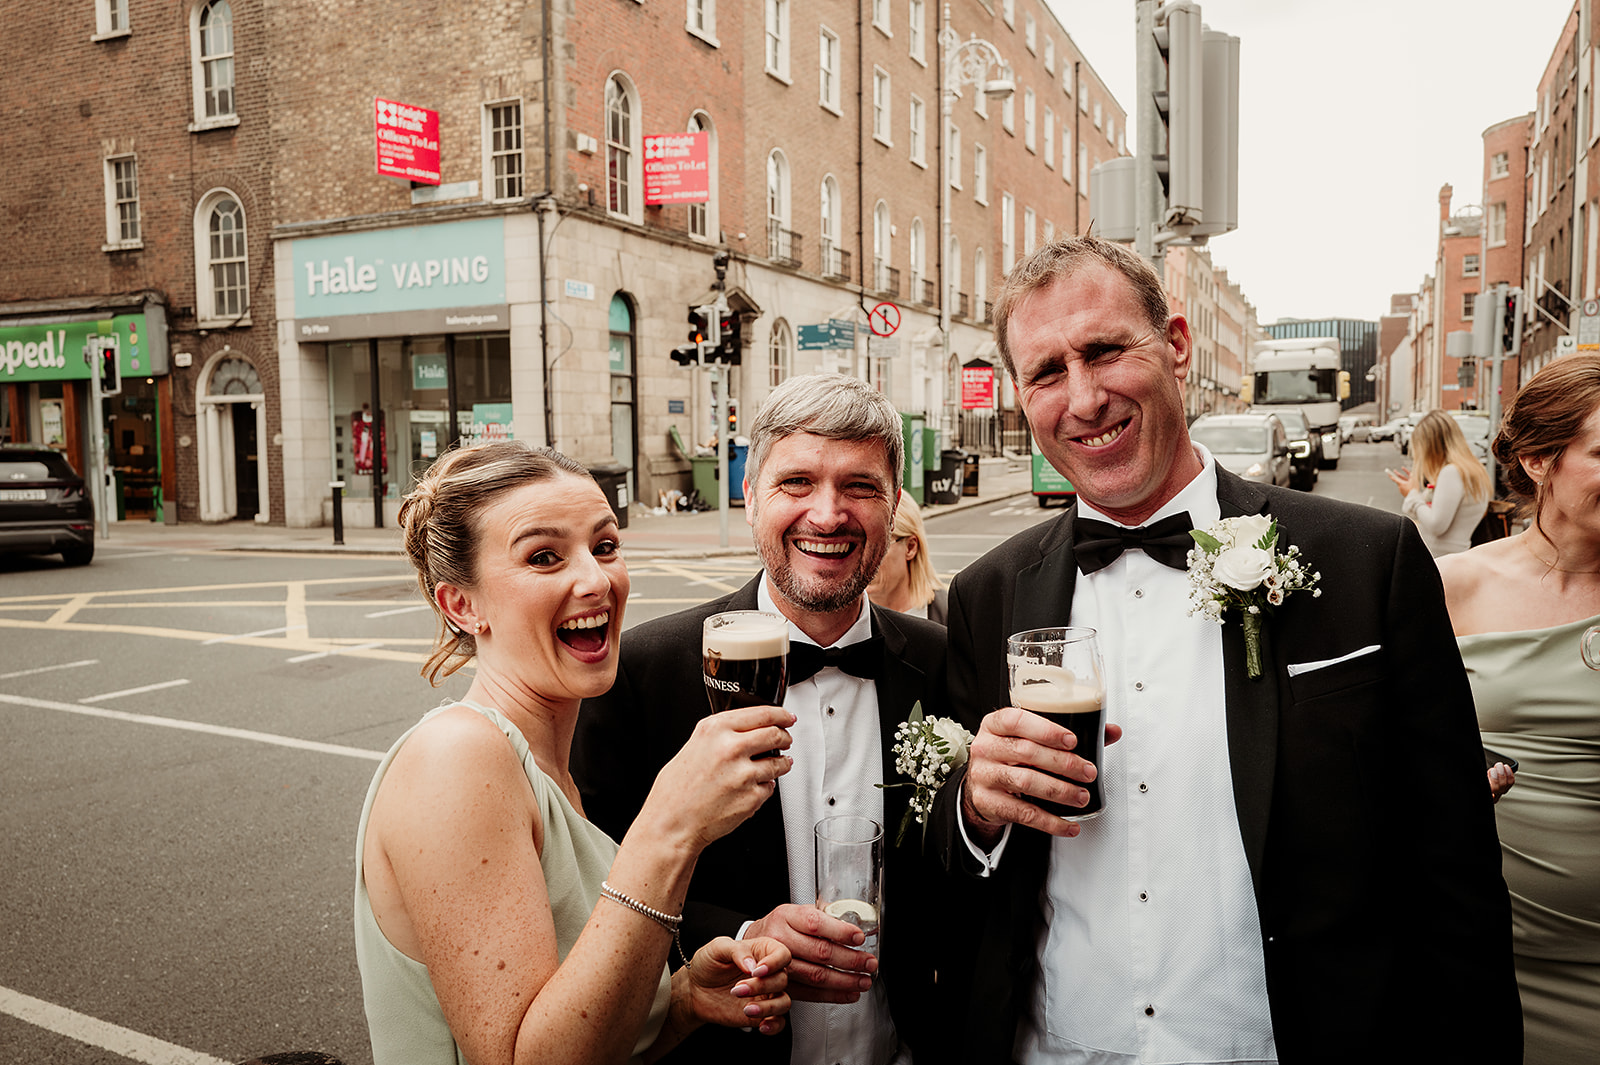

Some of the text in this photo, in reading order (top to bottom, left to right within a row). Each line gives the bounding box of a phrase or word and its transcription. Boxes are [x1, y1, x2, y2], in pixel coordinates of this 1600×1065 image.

[397, 105, 427, 122] Knight
[398, 117, 423, 132] Frank
[378, 128, 410, 144] Offices
[410, 134, 423, 147] To
[424, 137, 438, 151] Let
[665, 136, 694, 147] Knight
[665, 147, 690, 157] Frank
[645, 160, 706, 172] Offices To Let
[305, 256, 377, 296] Hale
[391, 256, 489, 289] VAPING
[418, 364, 445, 379] Hale
[460, 420, 513, 434] Irish mad
[703, 673, 741, 693] UINNESS
